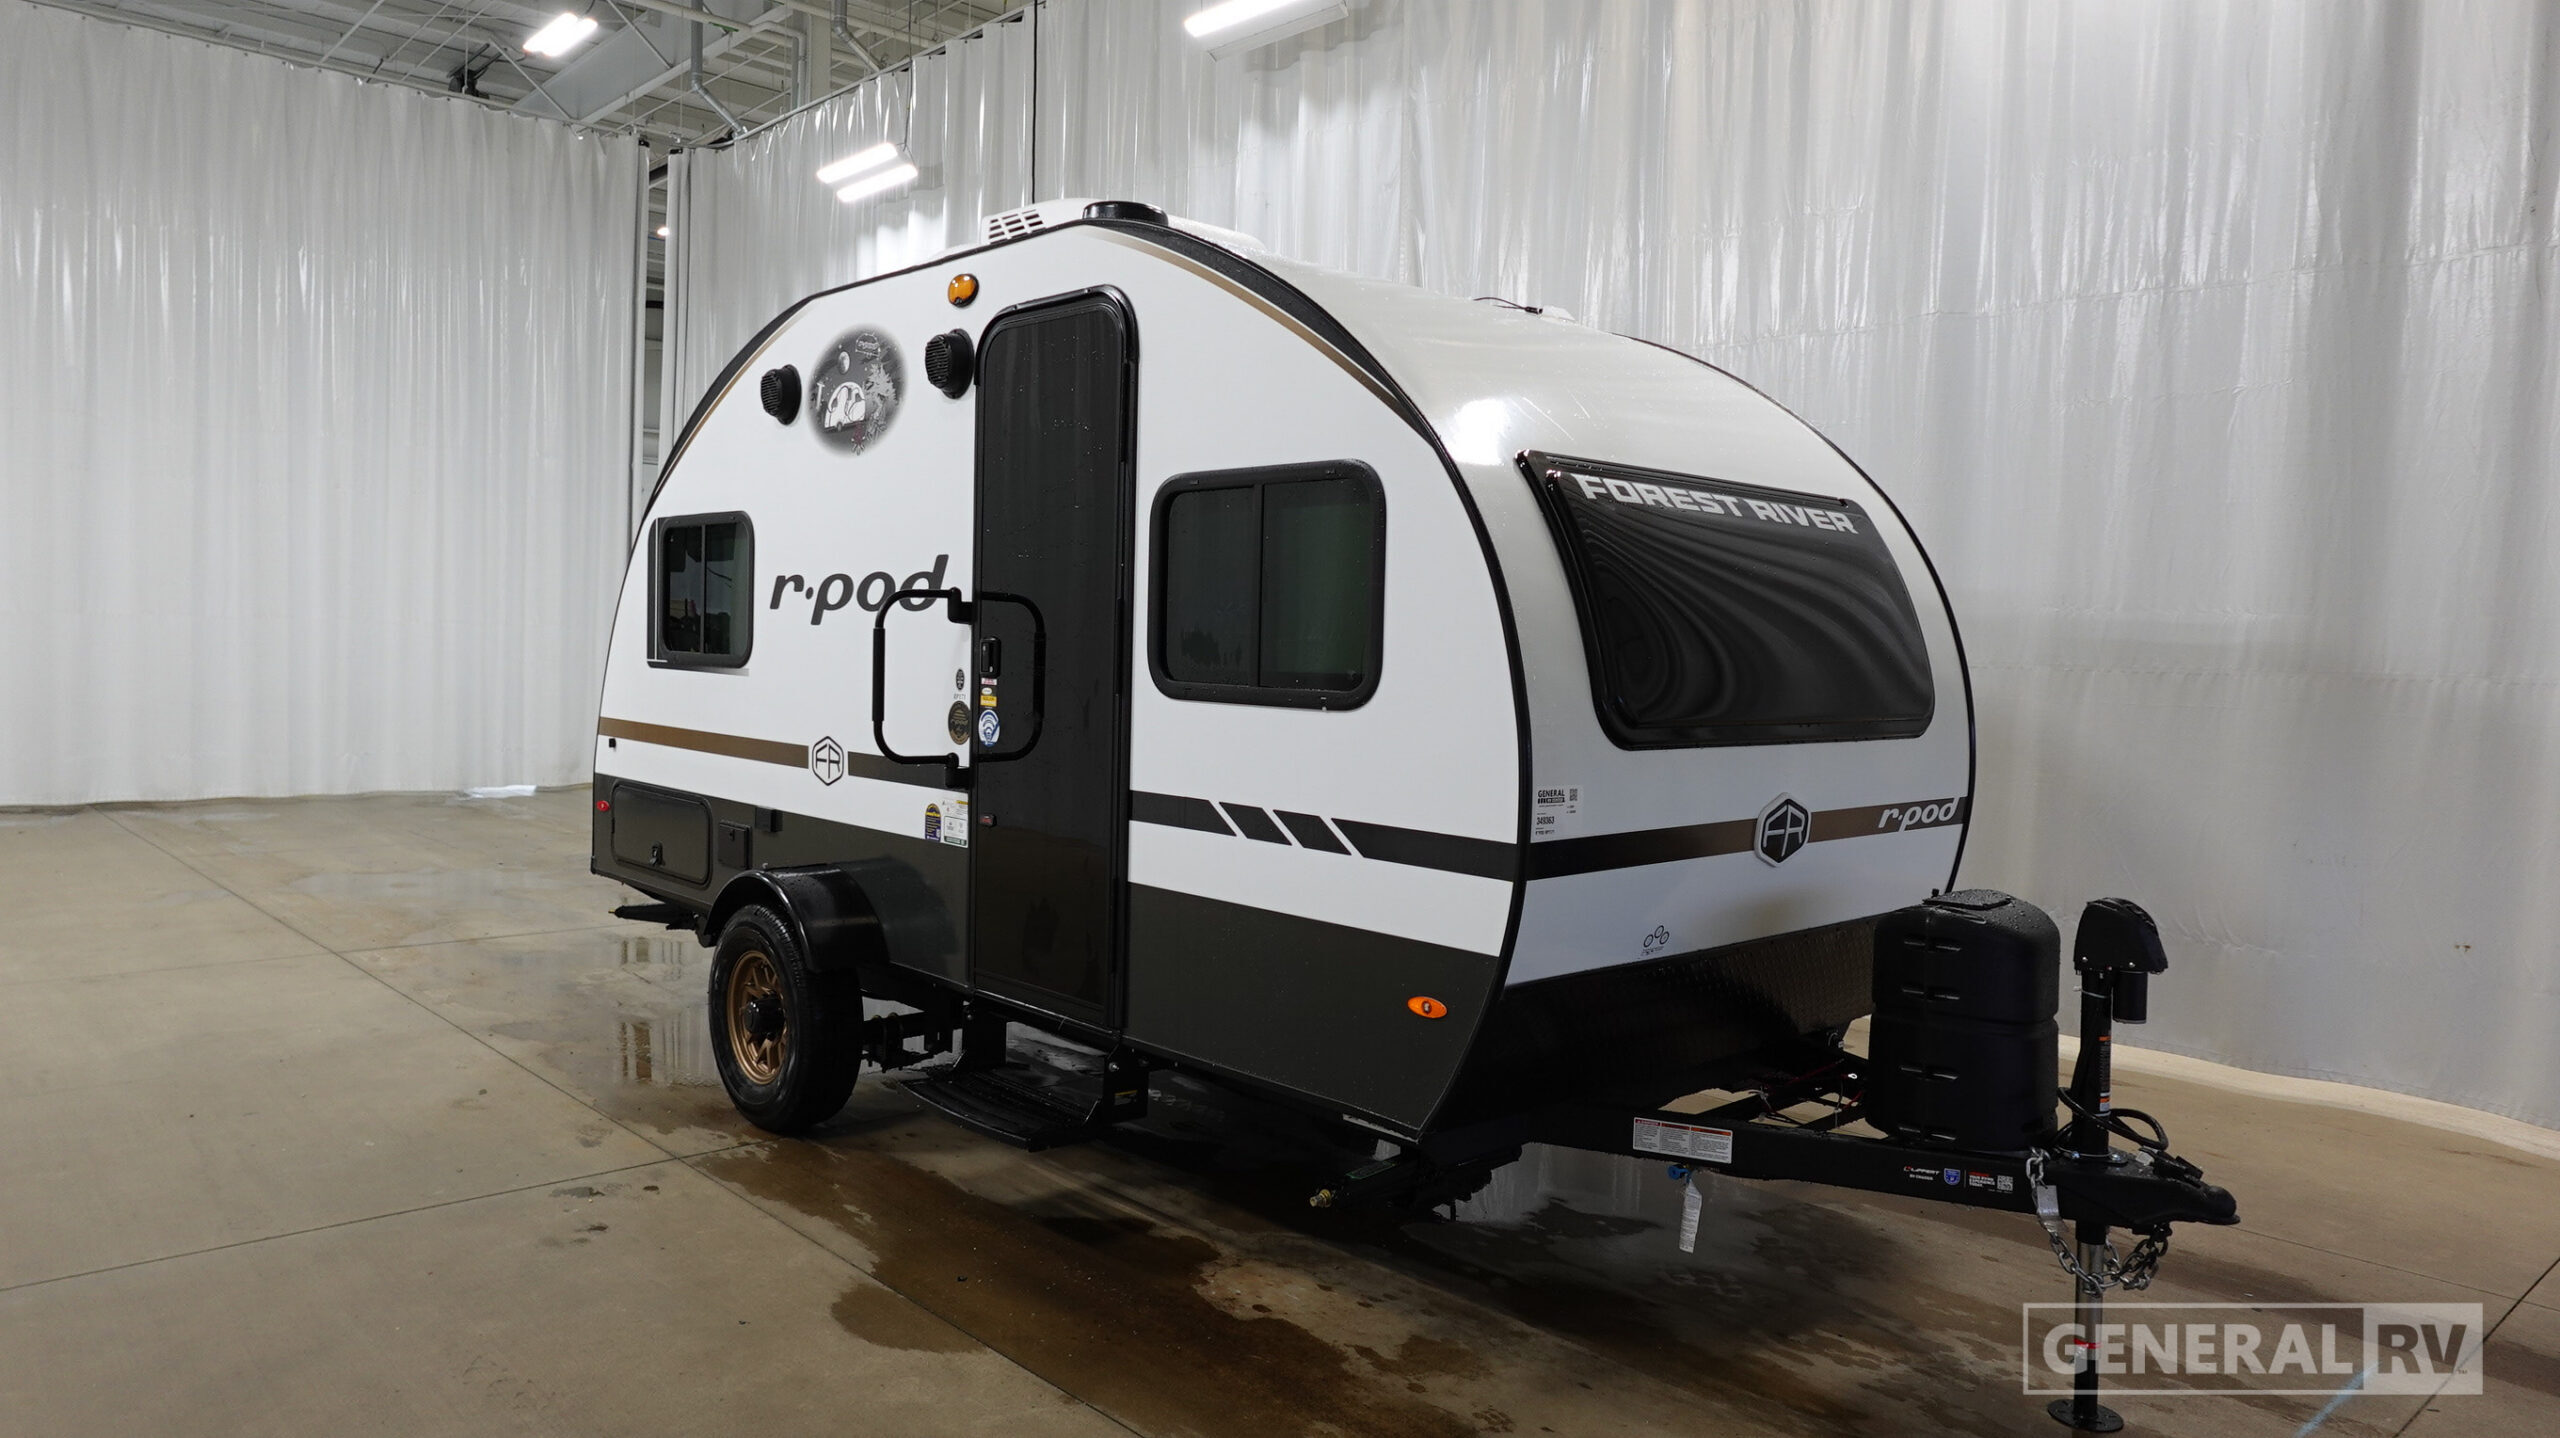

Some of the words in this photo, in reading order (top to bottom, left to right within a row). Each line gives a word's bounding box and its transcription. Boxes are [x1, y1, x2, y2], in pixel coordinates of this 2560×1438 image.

[1571, 473, 1743, 517] FOREST
[1744, 498, 1859, 534] RIVER
[1537, 789, 1565, 798] GENERAL
